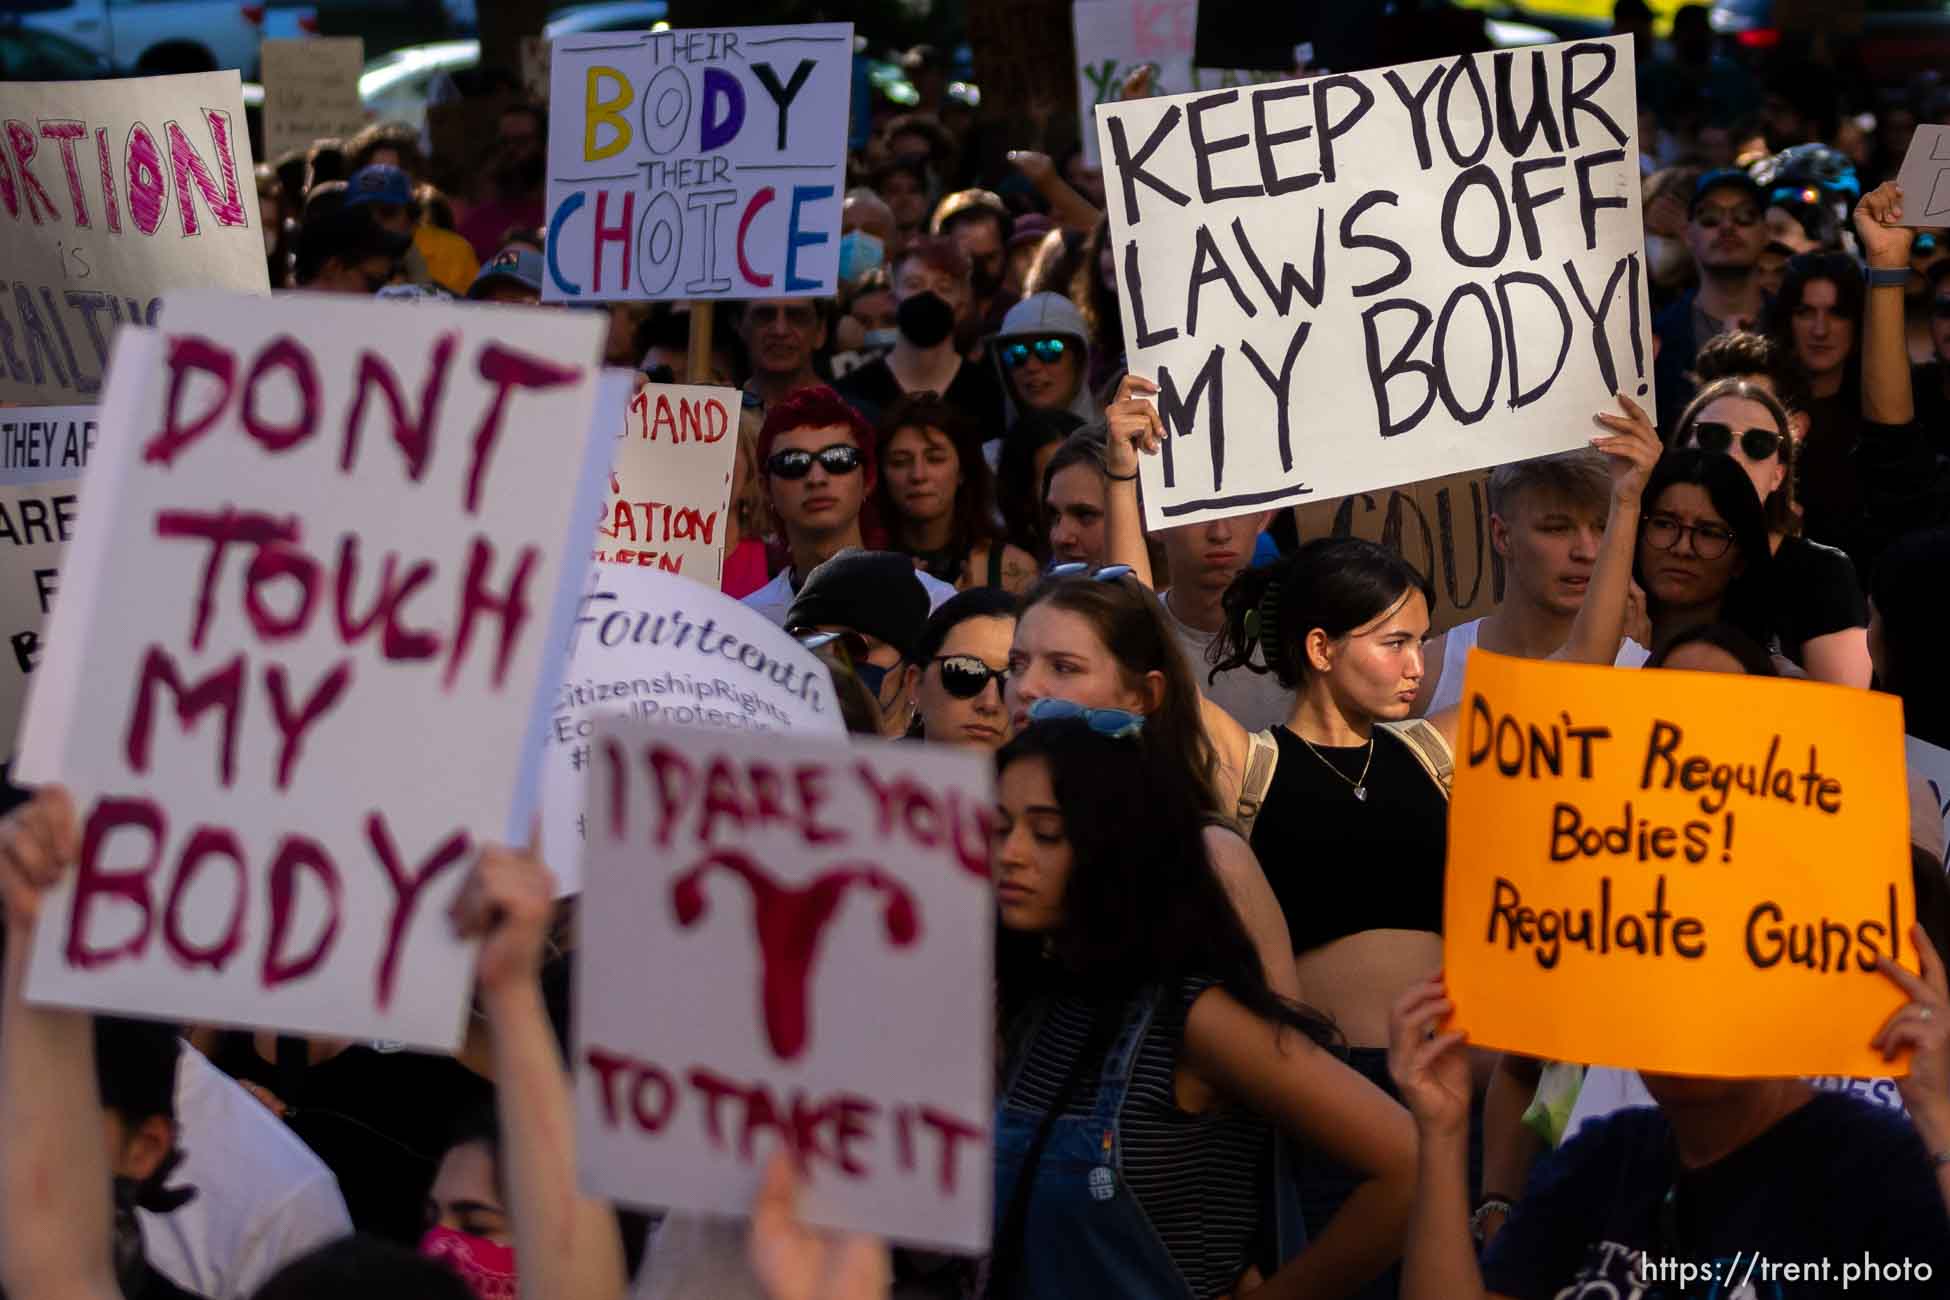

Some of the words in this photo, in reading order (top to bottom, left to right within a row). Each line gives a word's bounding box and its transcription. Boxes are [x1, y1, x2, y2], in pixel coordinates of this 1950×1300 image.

[583, 59, 819, 162] BODY
[642, 32, 745, 66] THEIR
[637, 157, 733, 190] THEIR
[1106, 73, 1376, 226] KEEP
[1383, 42, 1631, 170] YOUR
[57, 240, 91, 280] is
[547, 184, 835, 296] CHOICE
[1124, 189, 1413, 350] LAWS
[1440, 149, 1629, 269] OFF
[142, 331, 586, 516] DONT
[617, 391, 729, 444] MAND
[1157, 320, 1313, 492] MY
[1361, 250, 1649, 439] BODY!
[2, 421, 58, 468] THEY
[155, 502, 543, 693] TOUCH
[123, 643, 352, 790] MY
[1467, 691, 1612, 781] DON'T
[1640, 719, 1843, 815] Regulate
[603, 736, 630, 842] I
[646, 738, 849, 852] DARE
[852, 755, 993, 880] YOU
[1548, 801, 1735, 865] Bodies!
[65, 792, 474, 1014] BODY
[1486, 873, 1708, 970] Regulate
[1744, 880, 1901, 974] Guns!
[585, 1045, 678, 1136] TO
[687, 1066, 880, 1188] TAKE
[892, 1098, 985, 1199] IT
